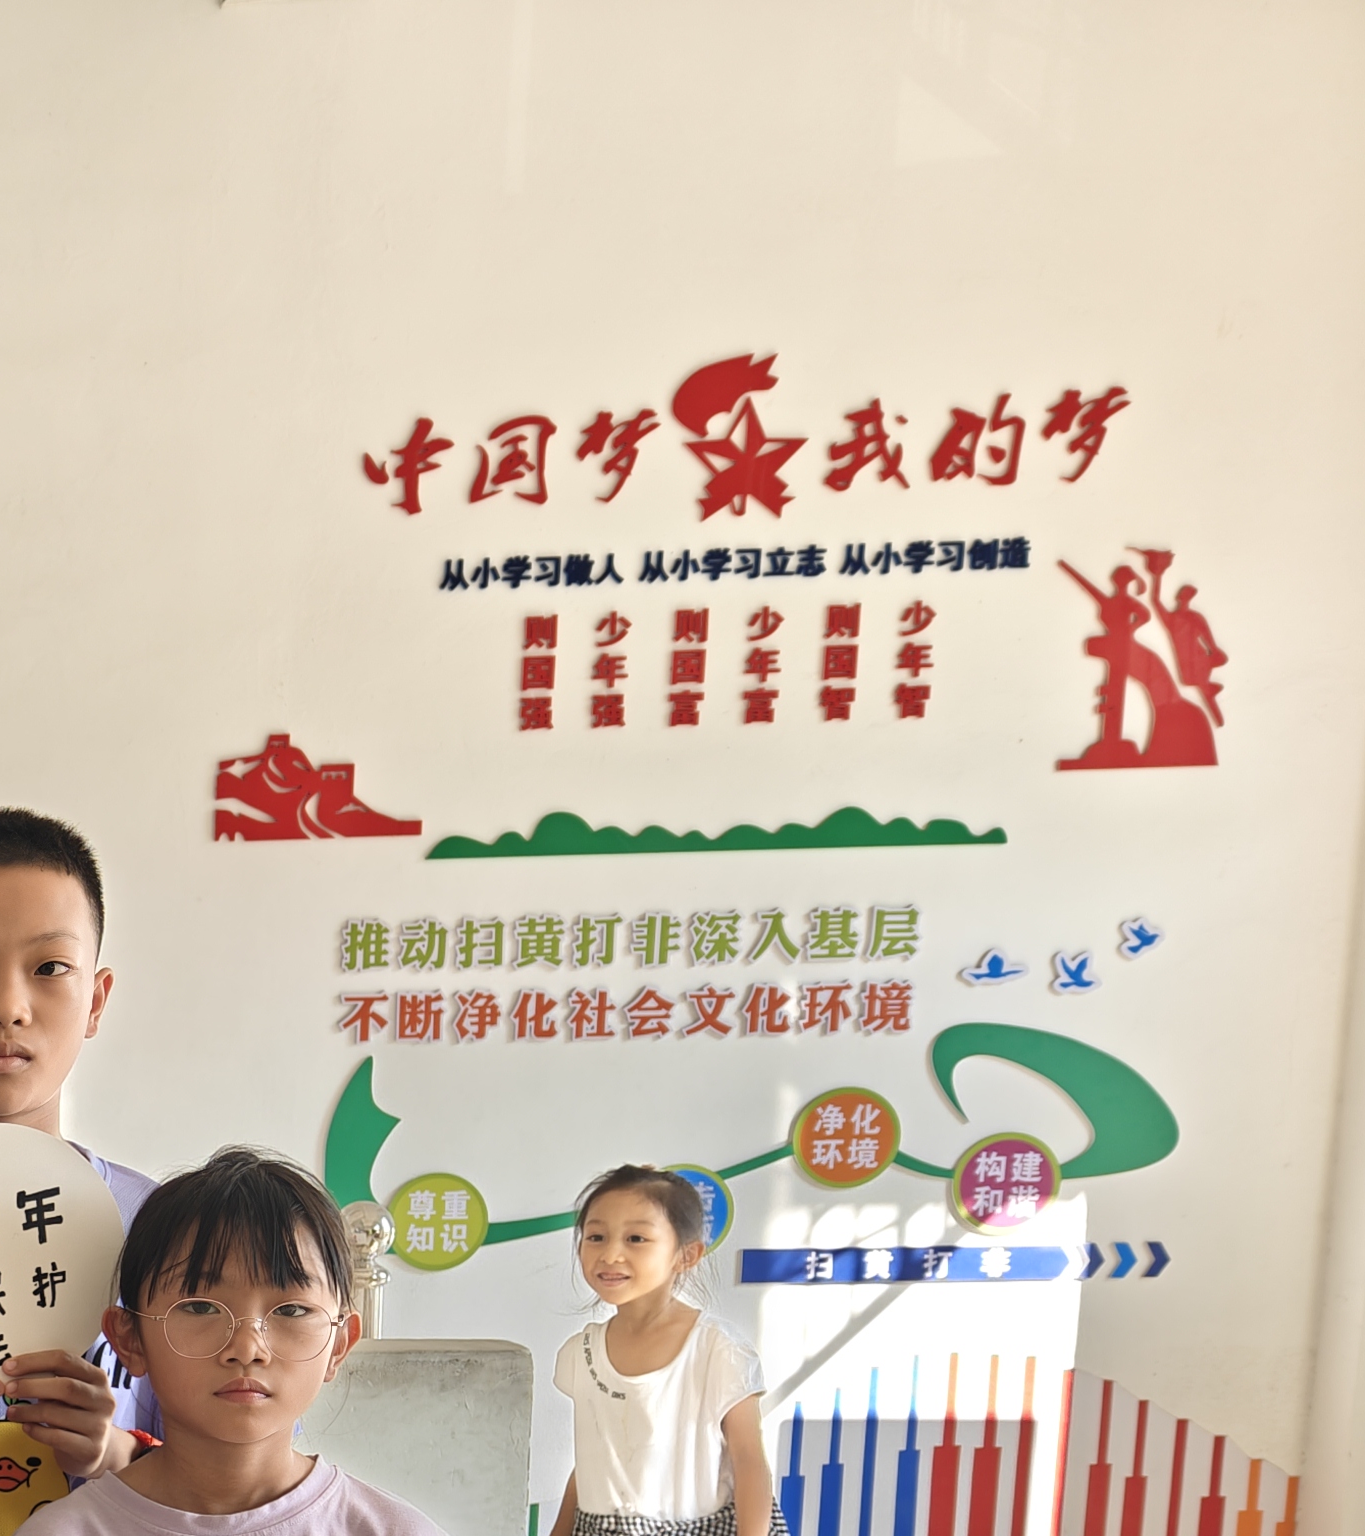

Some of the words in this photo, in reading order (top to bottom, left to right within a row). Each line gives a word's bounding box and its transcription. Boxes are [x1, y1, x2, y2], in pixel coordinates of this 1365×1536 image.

[362, 408, 661, 516] 中国梦
[824, 385, 1132, 492] 我的梦
[439, 553, 624, 592] 从小学习做人
[638, 544, 826, 584] 从小学习立志
[839, 536, 1031, 576] 从小学习创造
[519, 614, 558, 731] 则国强
[591, 611, 632, 728] 少年强
[667, 608, 709, 727] 则国富
[743, 606, 784, 724] 少年富
[819, 603, 862, 721] 则国智
[895, 600, 936, 719] 少年智
[342, 907, 920, 971] 推动扫黄打非深入基层
[341, 982, 912, 1043] 不断净化社会文化环境
[813, 1103, 882, 1136] 净化
[811, 1137, 880, 1170] 环境
[974, 1150, 1044, 1184] 构建
[407, 1190, 471, 1222] 尊重
[972, 1185, 1041, 1218] 和谐
[406, 1223, 469, 1254] 知识
